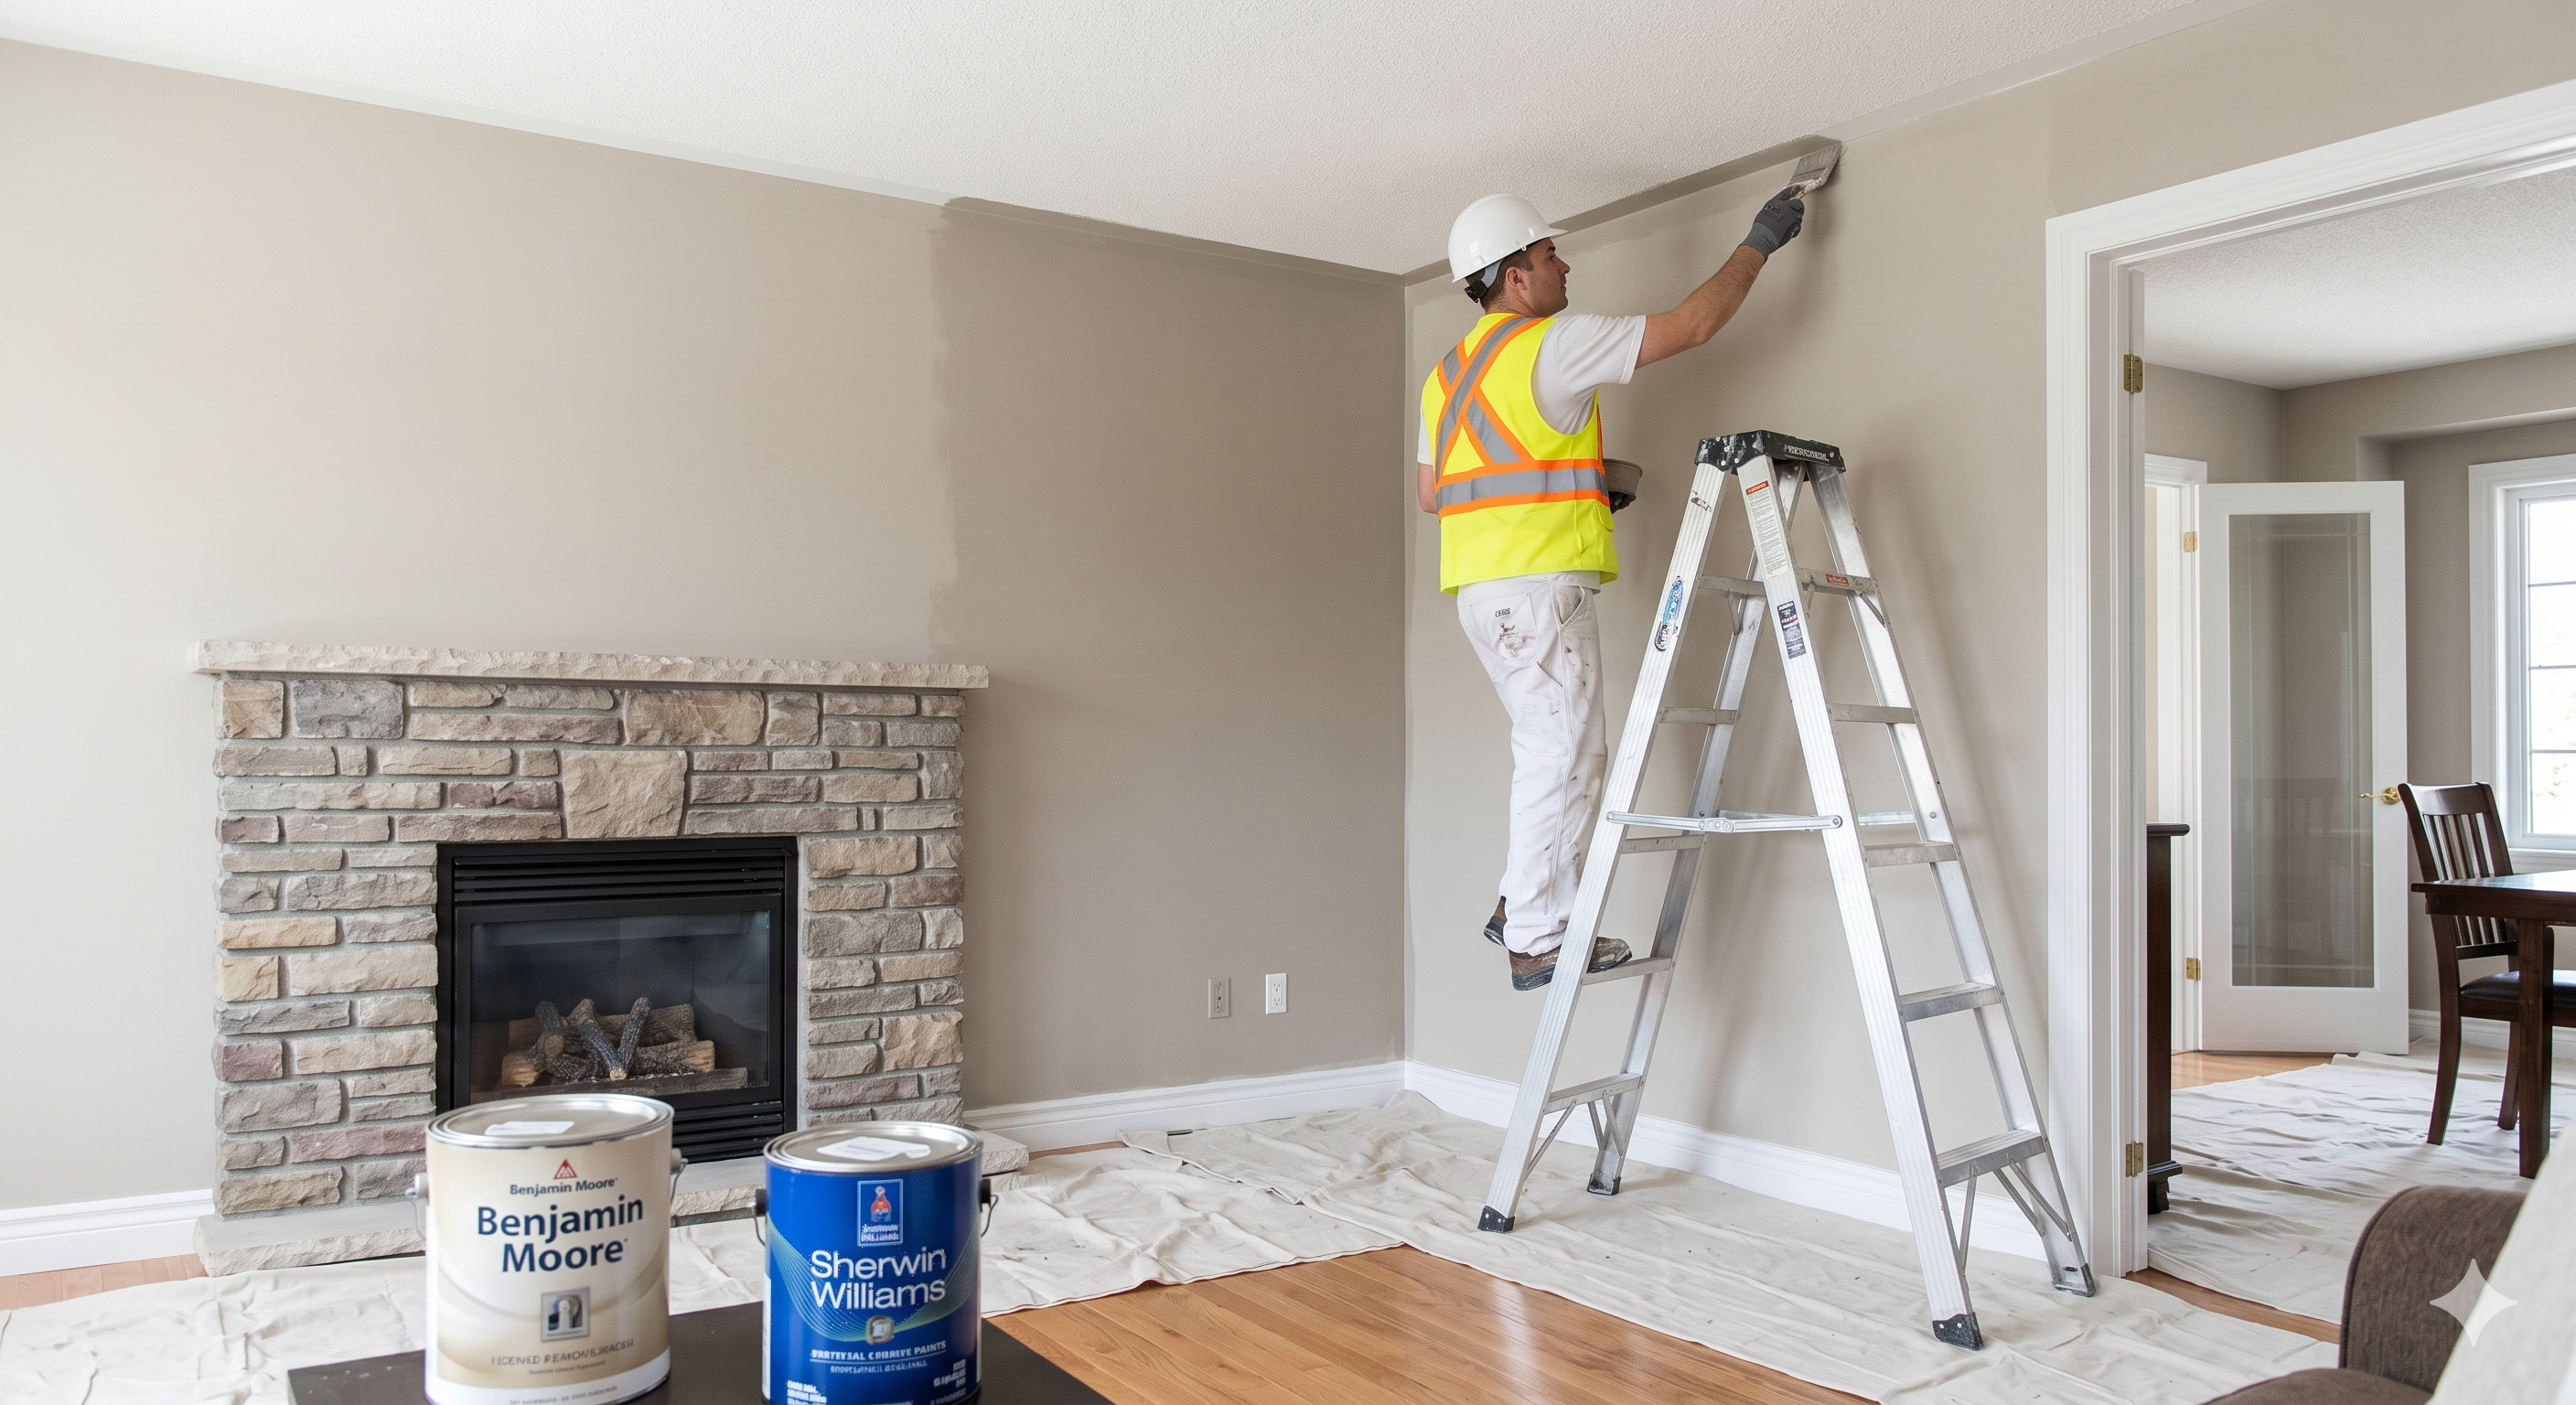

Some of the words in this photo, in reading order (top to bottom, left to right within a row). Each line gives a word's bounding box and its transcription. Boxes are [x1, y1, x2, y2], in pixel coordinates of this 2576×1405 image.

[510, 1183, 572, 1196] Benjamin
[575, 1178, 616, 1191] Moore
[478, 1195, 643, 1244] Benjamin
[502, 1239, 624, 1272] Moore
[810, 1246, 947, 1279] Sherwin
[810, 1279, 947, 1309] Williams
[914, 1340, 947, 1355] PAINTS
